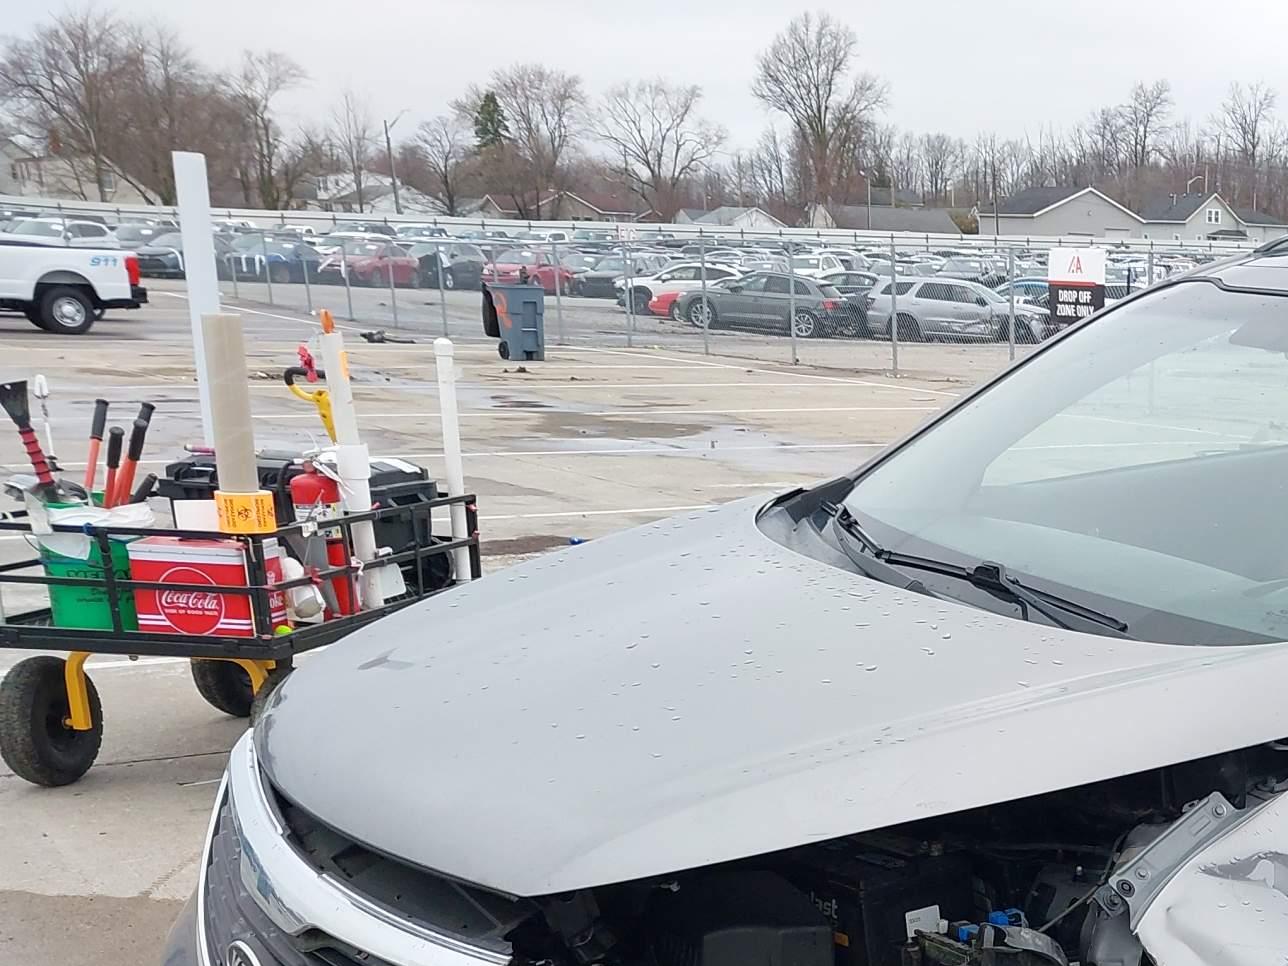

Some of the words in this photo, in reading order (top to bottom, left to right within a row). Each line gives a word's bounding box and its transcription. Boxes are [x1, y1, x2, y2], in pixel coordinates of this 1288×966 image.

[90, 255, 118, 268] 911
[1058, 289, 1078, 303] DROP
[1079, 290, 1092, 304] OFF
[1056, 303, 1077, 317] ZONE
[1077, 305, 1095, 318] ONLY
